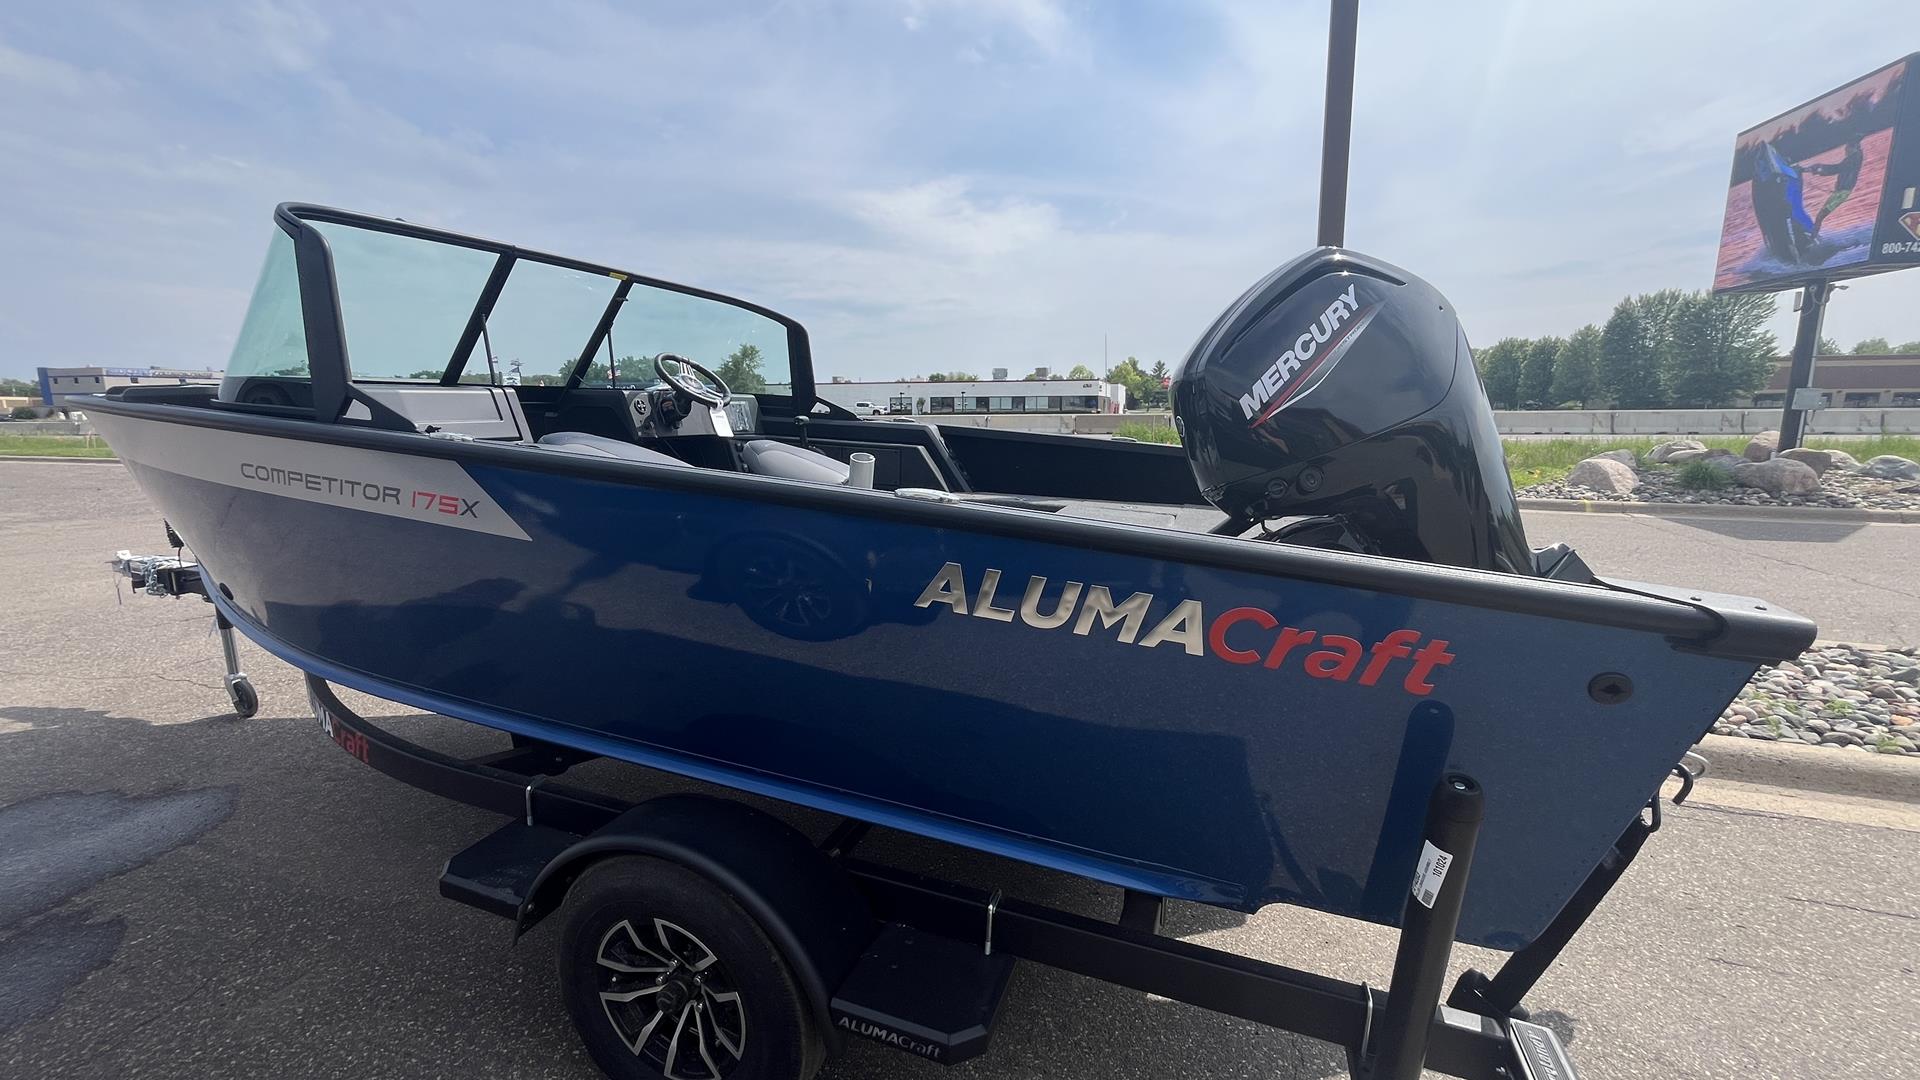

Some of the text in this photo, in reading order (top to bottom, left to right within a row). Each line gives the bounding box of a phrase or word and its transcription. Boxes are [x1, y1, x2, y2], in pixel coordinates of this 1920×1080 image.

[1238, 284, 1360, 420] MERCURY
[241, 462, 480, 518] COMPETITOR 175X
[914, 561, 1456, 695] ALUMACraft
[1432, 854, 1448, 878] 101024
[838, 1016, 941, 1058] ALUMACraft
